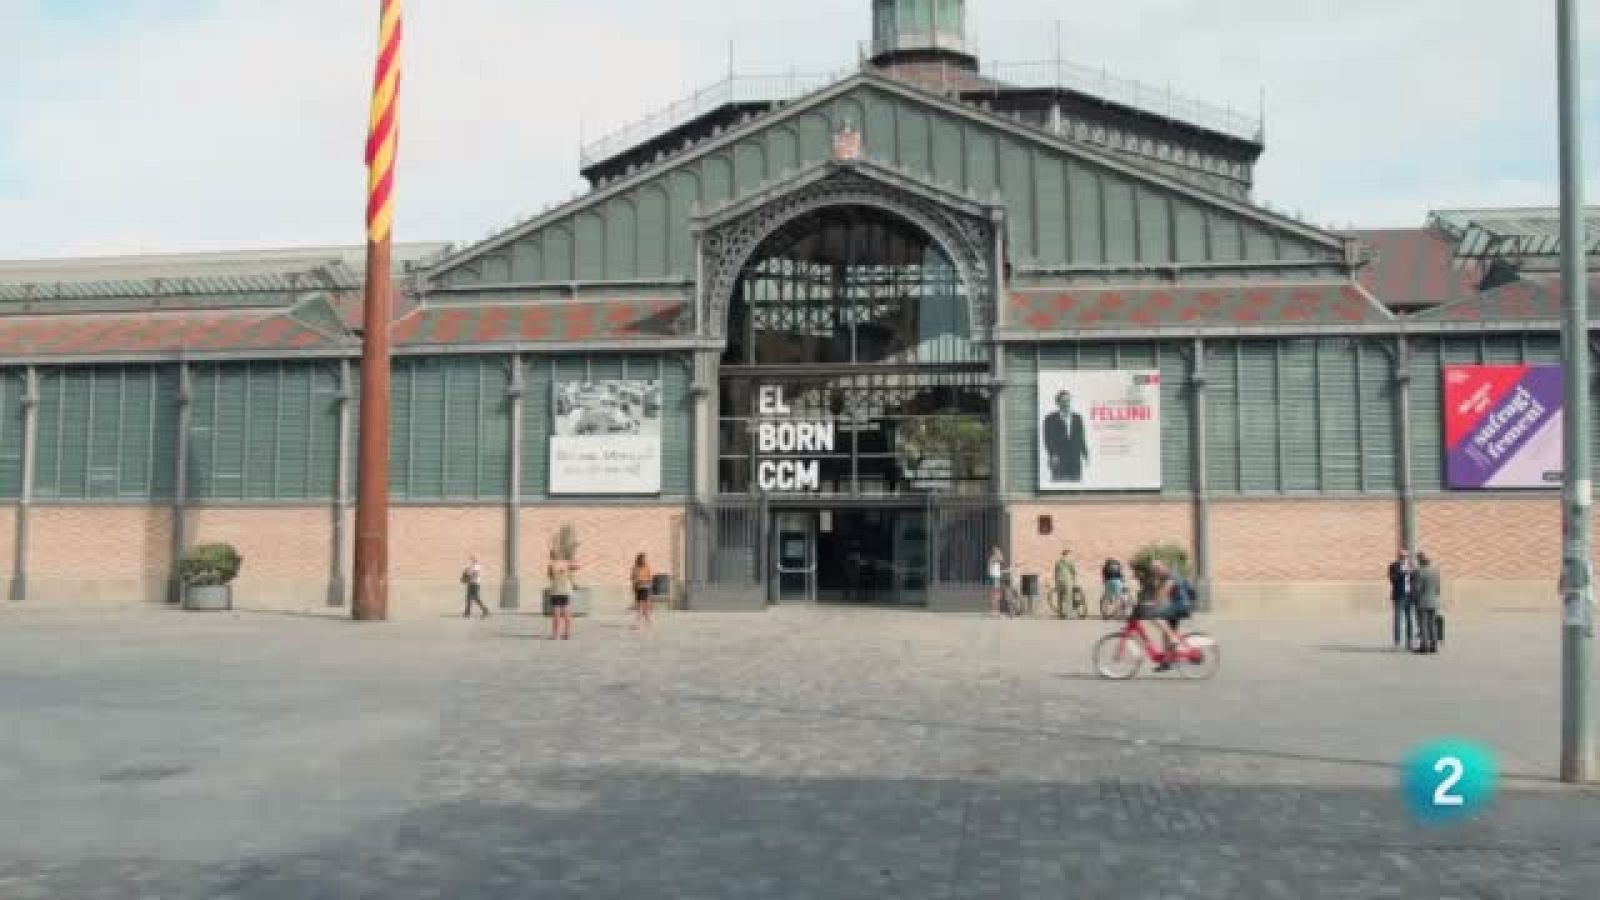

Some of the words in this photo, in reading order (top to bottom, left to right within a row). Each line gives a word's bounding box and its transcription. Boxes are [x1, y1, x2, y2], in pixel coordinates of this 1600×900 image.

[760, 385, 790, 413] EL
[1089, 405, 1151, 420] FELLINI
[760, 422, 834, 451] BORN
[759, 460, 819, 490] CCM
